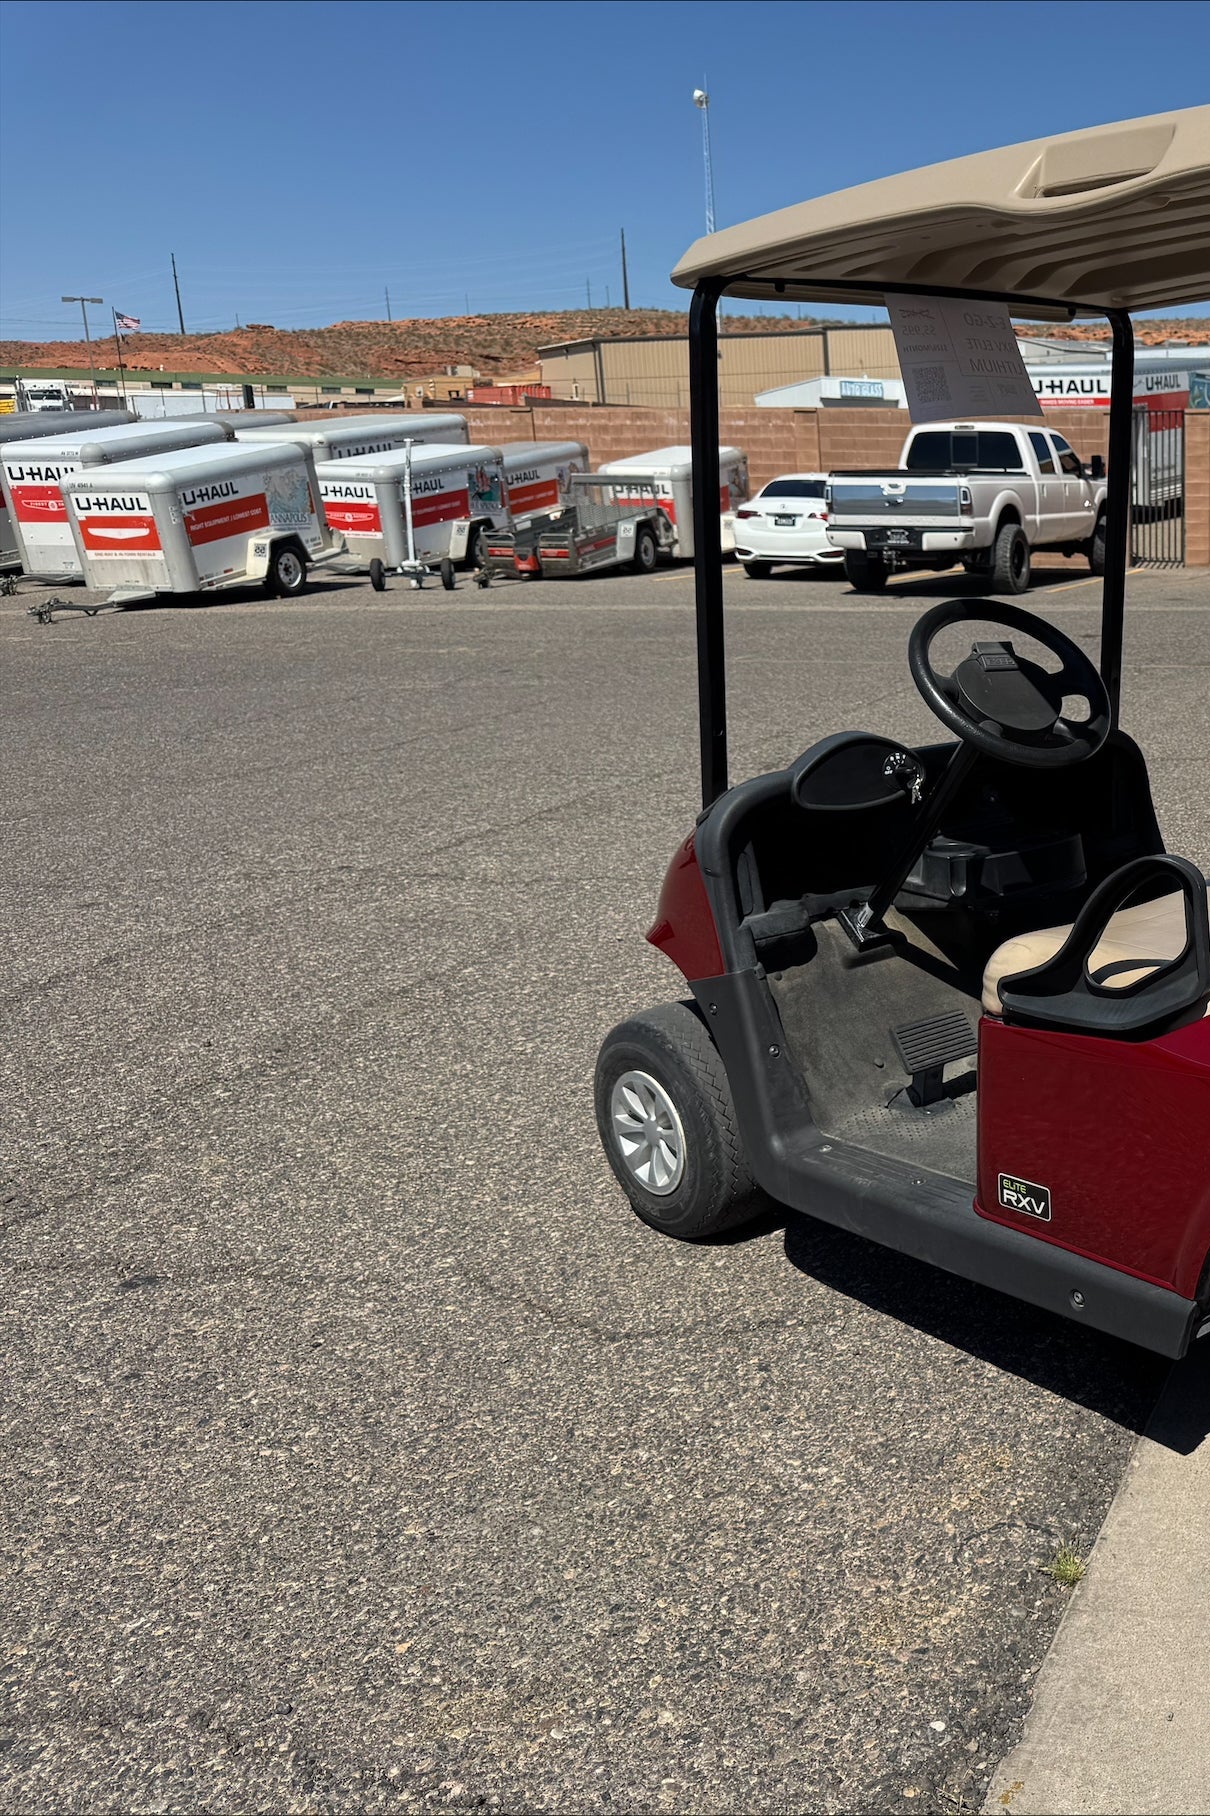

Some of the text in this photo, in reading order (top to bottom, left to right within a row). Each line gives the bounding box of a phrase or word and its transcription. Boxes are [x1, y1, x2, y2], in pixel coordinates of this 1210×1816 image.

[1146, 374, 1181, 391] U-HAUL
[7, 467, 75, 481] U-HA
[506, 470, 540, 486] U-HAUL
[182, 481, 239, 506] U-HAUL
[75, 497, 147, 511] U-HAUL
[1003, 1189, 1045, 1214] RXV
